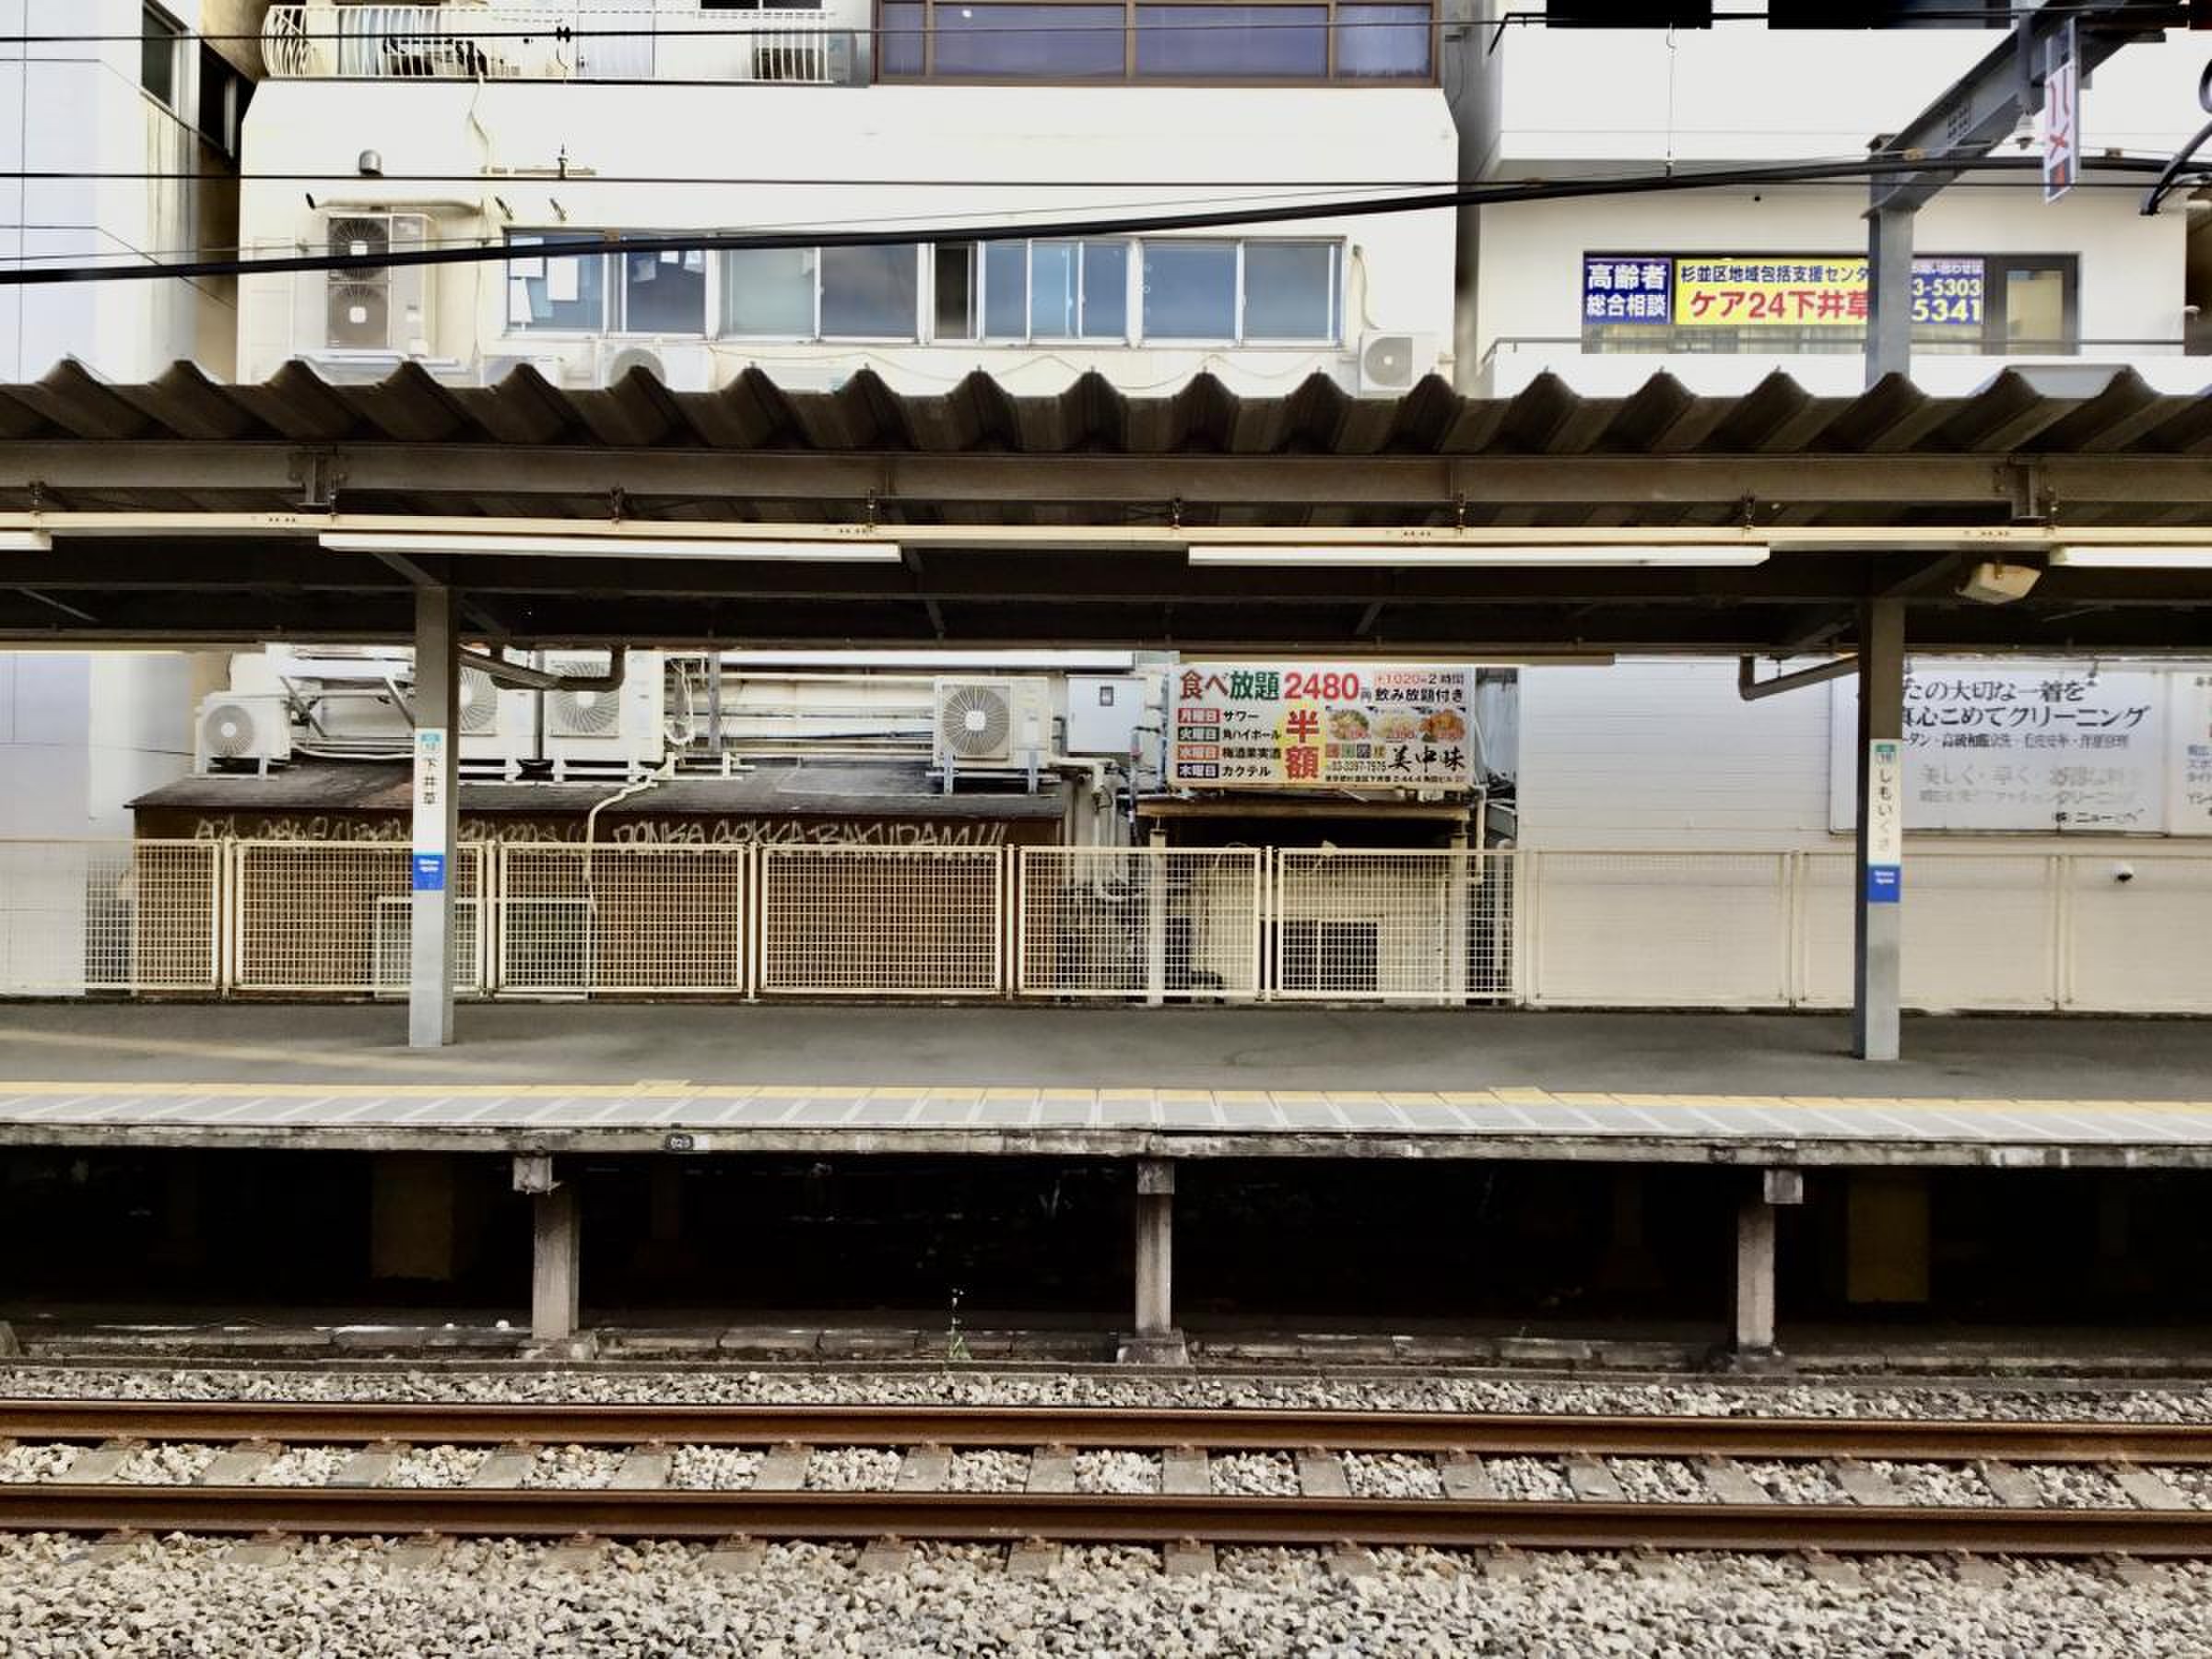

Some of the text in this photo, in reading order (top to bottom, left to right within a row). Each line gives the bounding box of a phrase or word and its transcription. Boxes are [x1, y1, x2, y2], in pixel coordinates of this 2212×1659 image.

[1588, 265, 1666, 290] 高齢者
[1587, 293, 1666, 317] 総合相談
[1912, 298, 1981, 322] 5341
[1180, 669, 1279, 700] 食べ放題
[1180, 709, 1259, 723] 月曜日 サワー
[1180, 727, 1218, 741] 火曜日
[1286, 709, 1320, 779] 半額
[1180, 764, 1270, 778] 木曜日 カクテル
